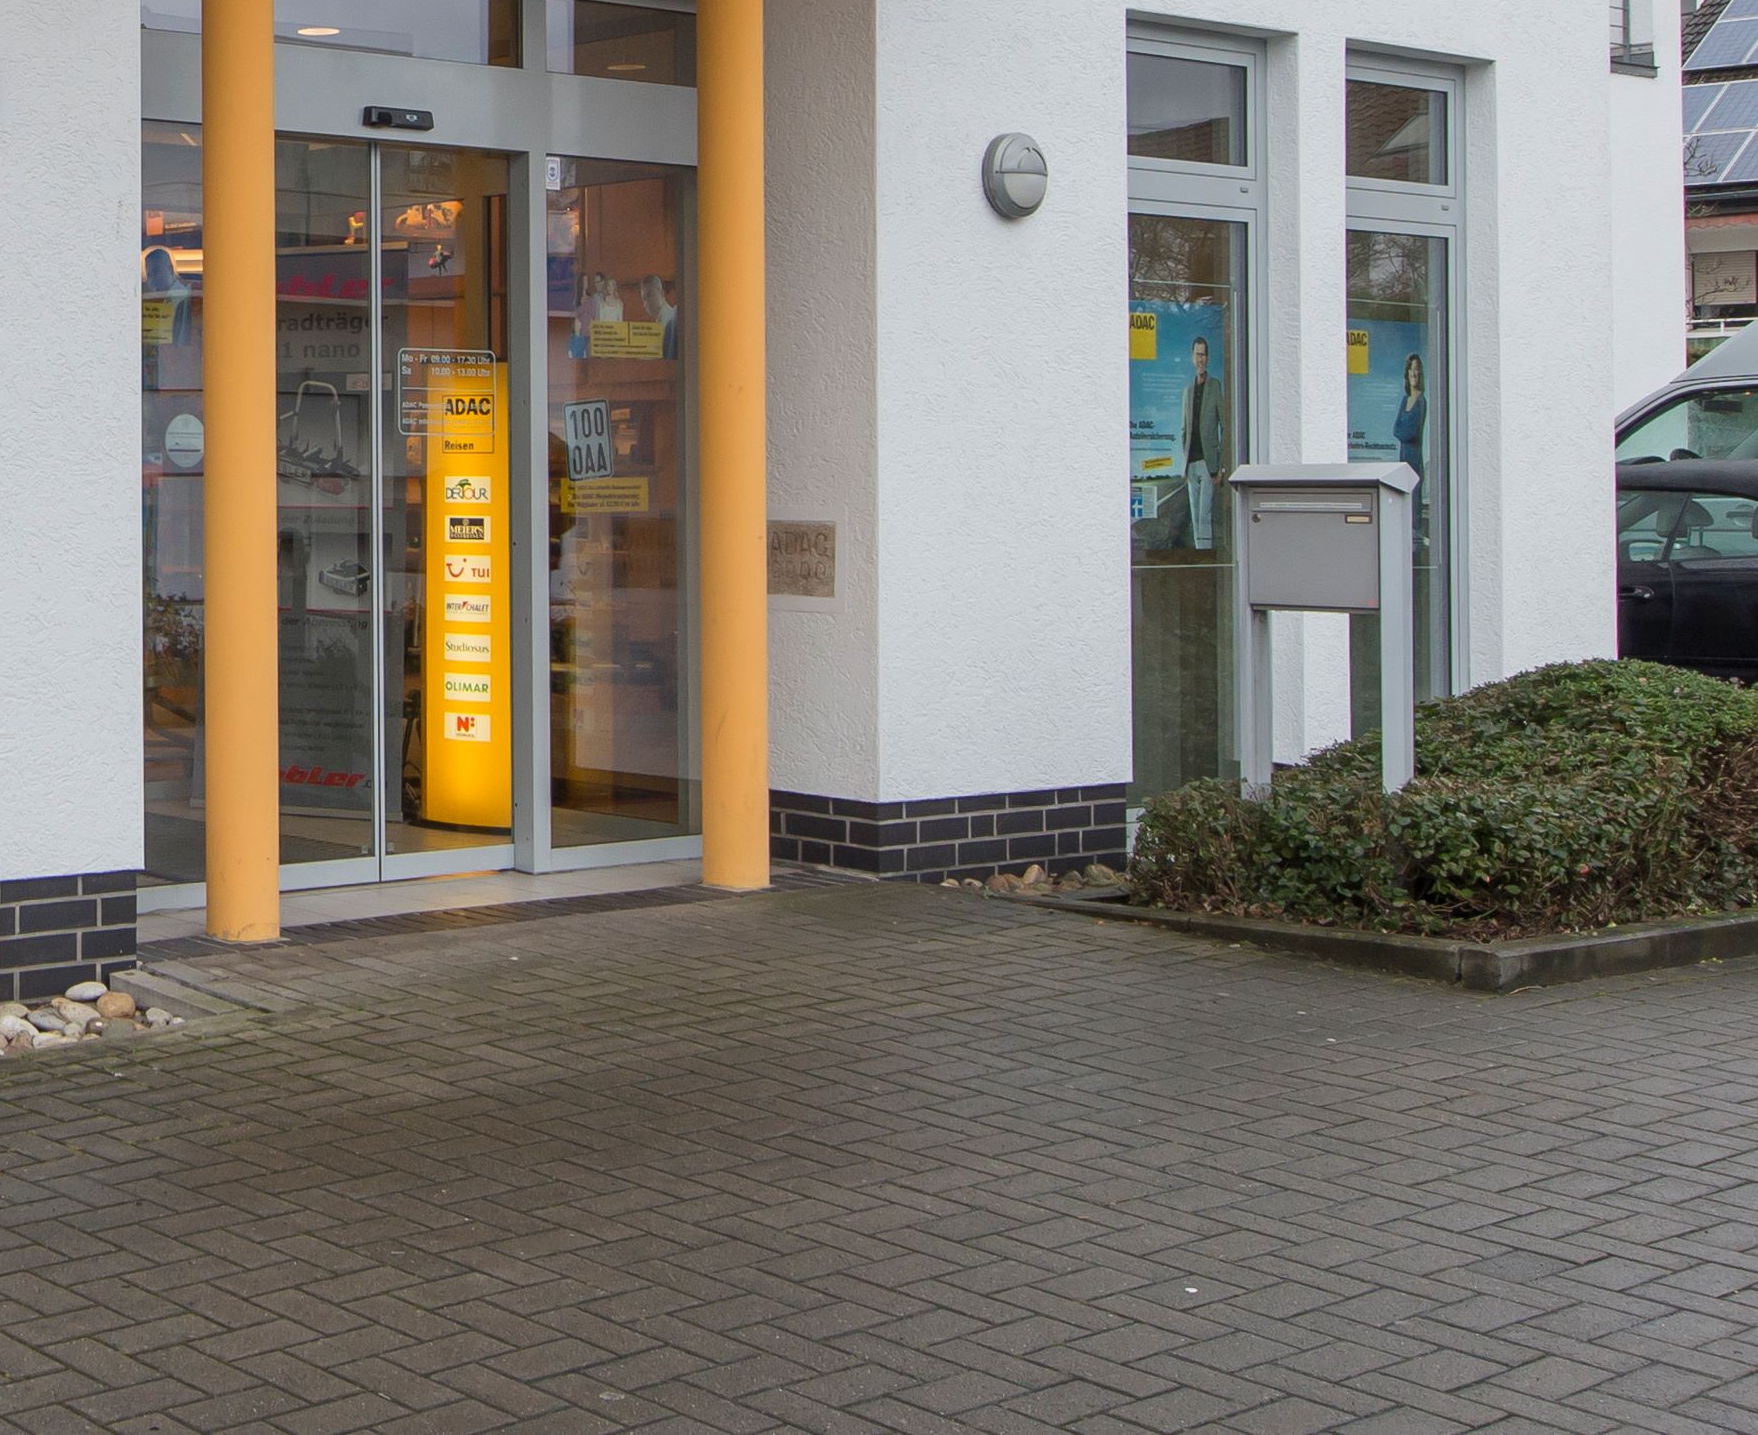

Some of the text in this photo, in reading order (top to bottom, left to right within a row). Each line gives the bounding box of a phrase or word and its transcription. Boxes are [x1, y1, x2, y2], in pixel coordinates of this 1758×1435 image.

[303, 343, 361, 359] nano
[402, 354, 414, 363] Mo
[419, 354, 428, 363] Fr
[477, 356, 491, 365] Uhr
[444, 398, 491, 416] ADAC
[570, 407, 605, 440] 100
[444, 440, 475, 451] Reisen
[445, 484, 489, 500] DERTOUR
[471, 568, 490, 578] TUI
[466, 603, 489, 612] CHALET
[445, 640, 490, 654] Studiosus
[445, 681, 489, 694] OLIMAR
